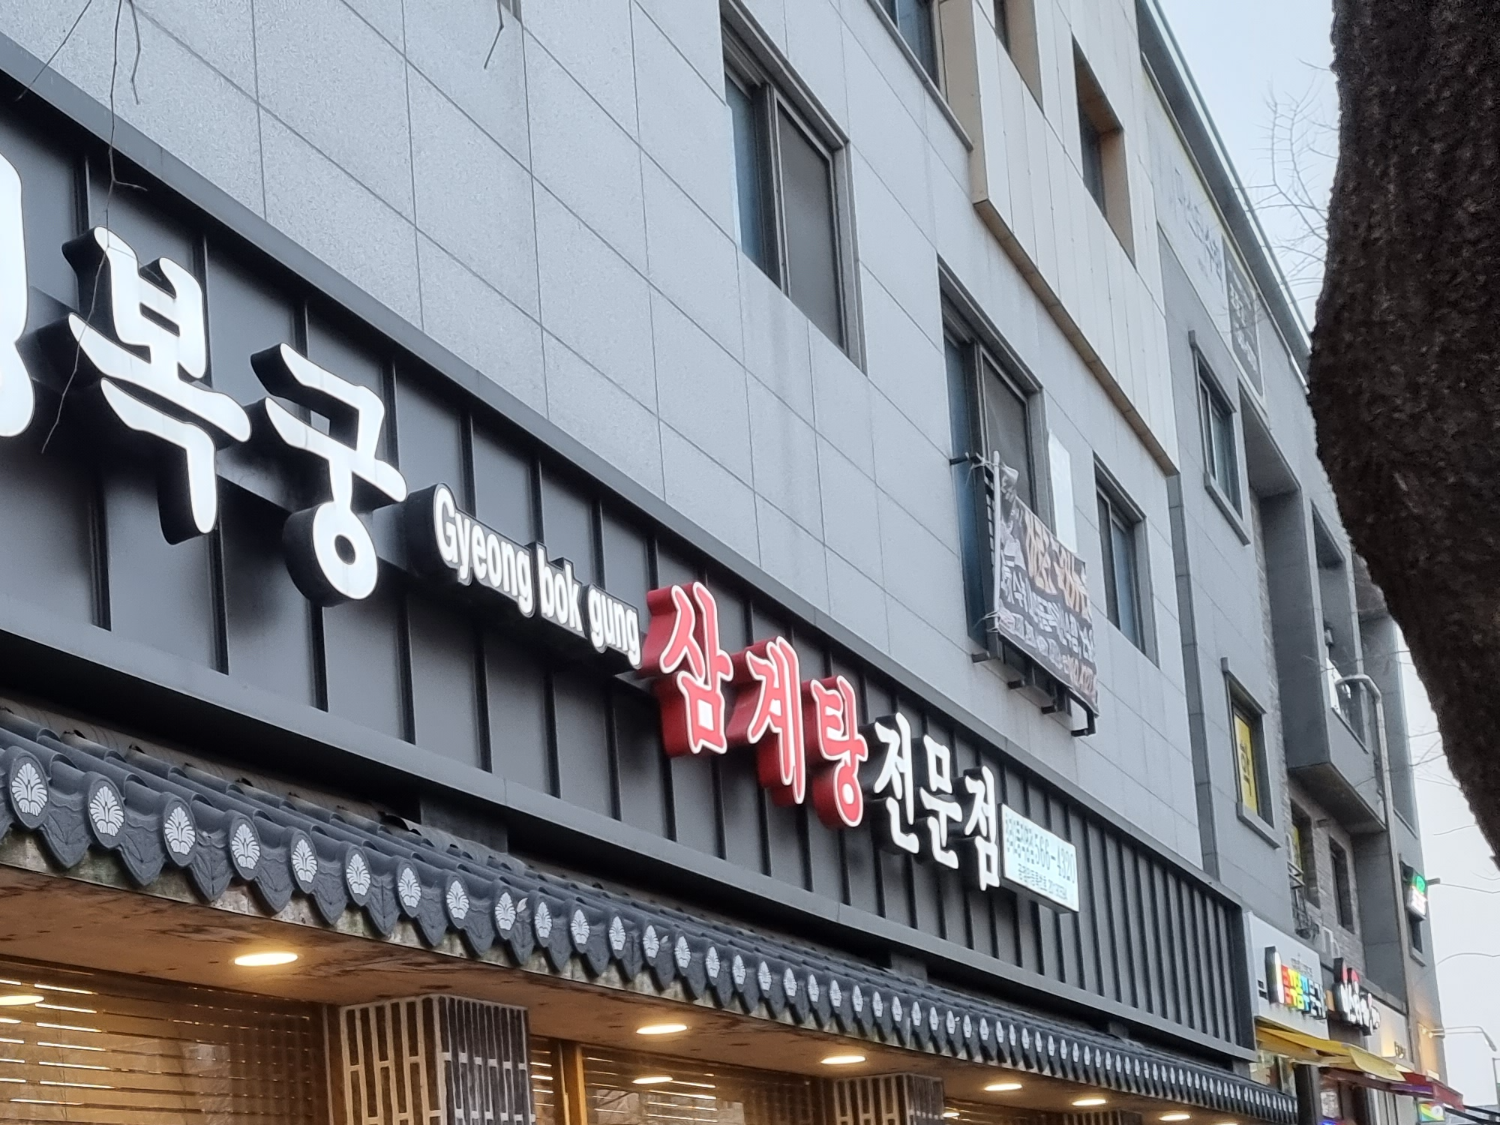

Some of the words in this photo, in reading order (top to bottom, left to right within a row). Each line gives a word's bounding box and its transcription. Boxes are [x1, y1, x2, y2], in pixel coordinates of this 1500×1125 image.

[434, 487, 534, 616] Gyeong
[538, 547, 584, 632] bok
[588, 588, 641, 667] gung
